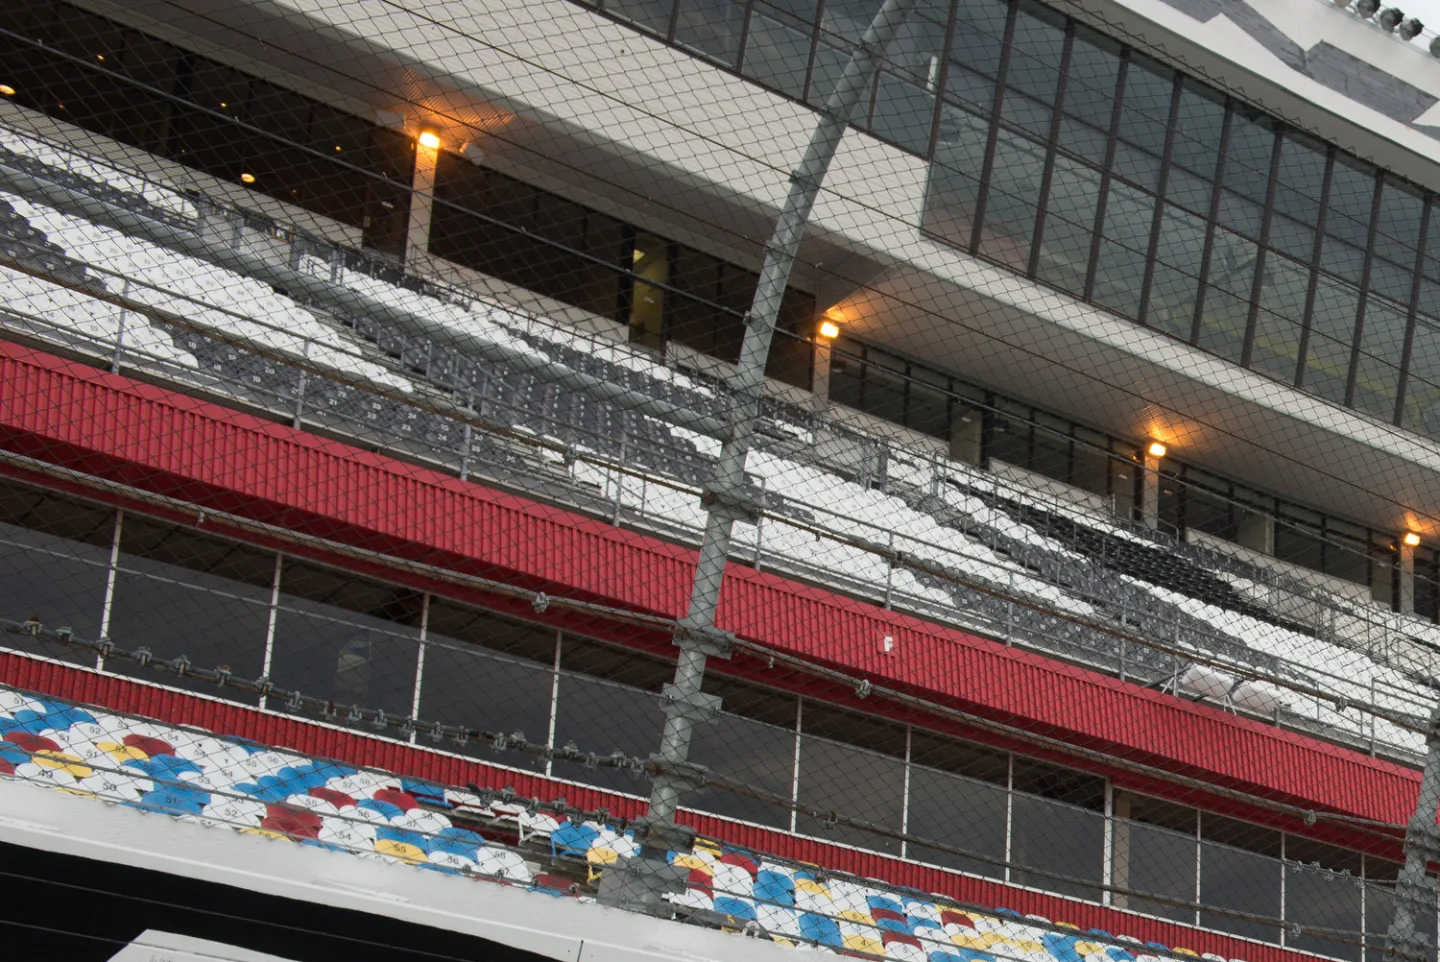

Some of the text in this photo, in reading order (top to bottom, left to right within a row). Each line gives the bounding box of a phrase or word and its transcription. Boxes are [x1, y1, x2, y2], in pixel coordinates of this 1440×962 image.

[167, 733, 178, 741] 54
[86, 750, 98, 758] 51
[38, 770, 53, 779] 49
[222, 770, 233, 778] 54
[103, 782, 117, 791] 50
[225, 809, 238, 817] 52
[358, 810, 369, 818] 56
[339, 831, 351, 840] 54
[394, 845, 406, 853] 55
[494, 851, 506, 859] 58
[447, 857, 459, 865] 56
